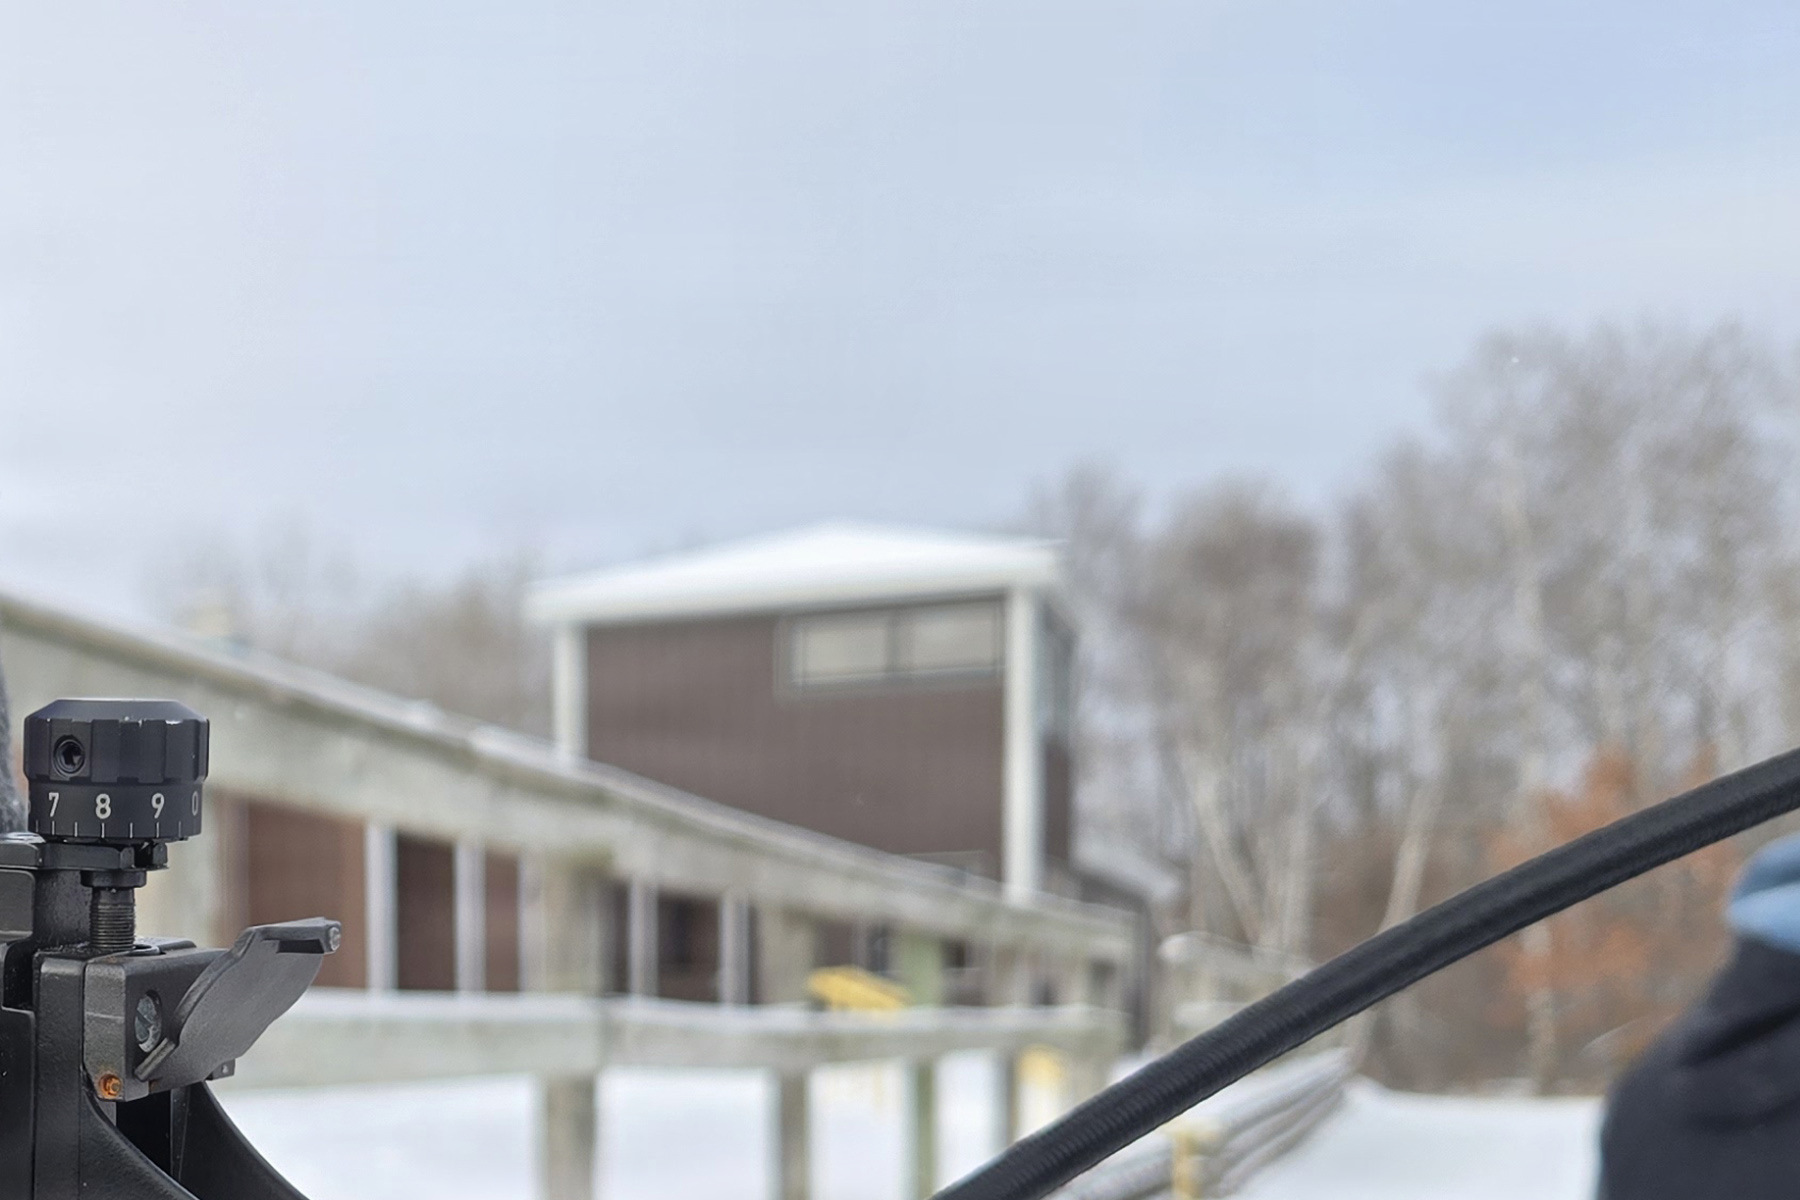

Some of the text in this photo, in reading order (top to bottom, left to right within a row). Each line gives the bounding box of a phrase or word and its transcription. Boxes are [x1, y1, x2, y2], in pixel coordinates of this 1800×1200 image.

[48, 792, 59, 817] 7
[95, 793, 111, 819] 8
[151, 793, 165, 819] 9
